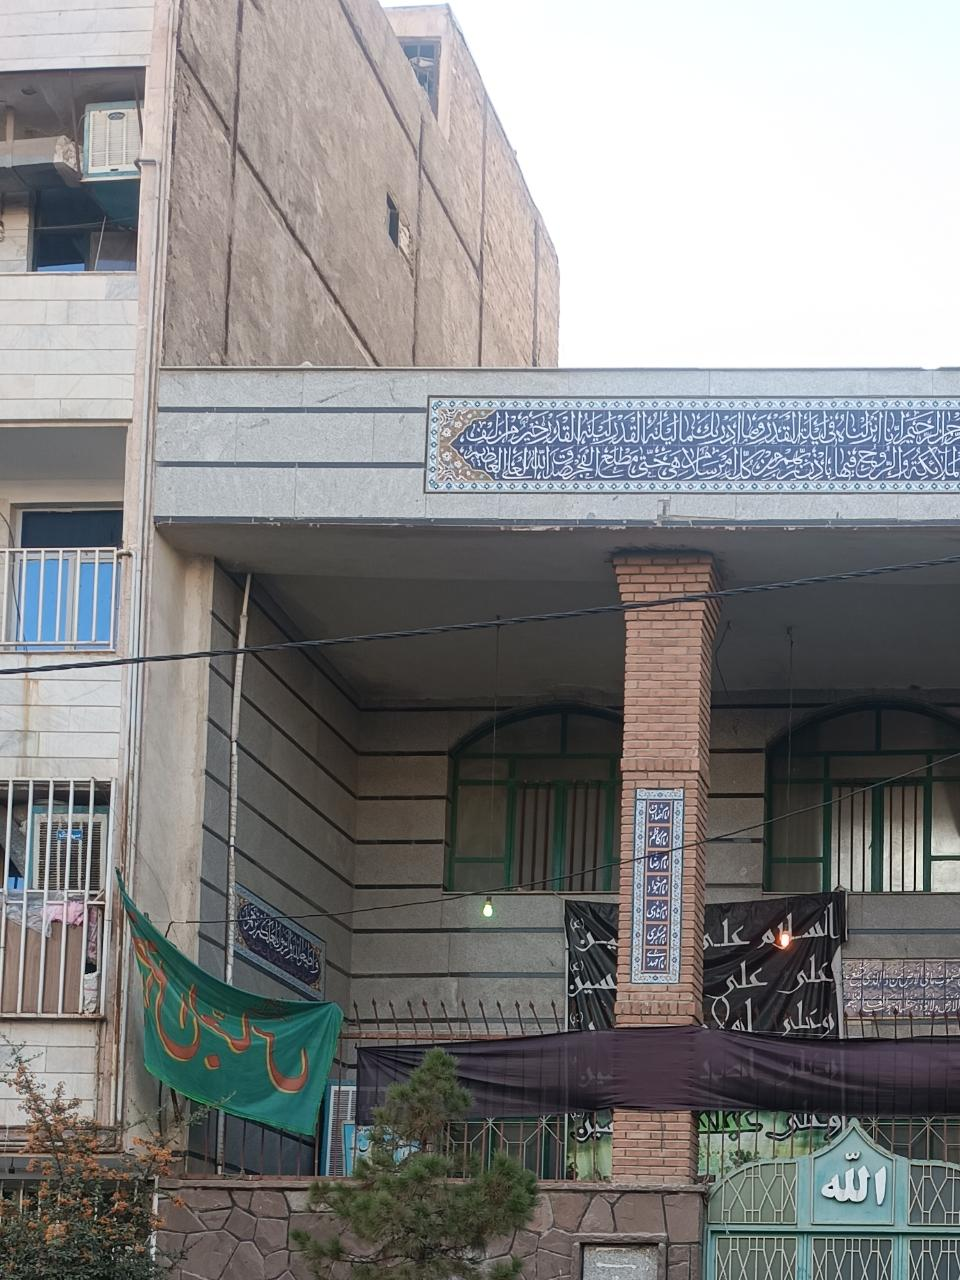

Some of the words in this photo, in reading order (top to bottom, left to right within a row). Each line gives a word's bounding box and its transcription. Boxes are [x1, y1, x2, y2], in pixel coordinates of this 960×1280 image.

[703, 917, 751, 951] علی
[756, 902, 841, 949] السلام
[821, 1151, 888, 1206] الله
